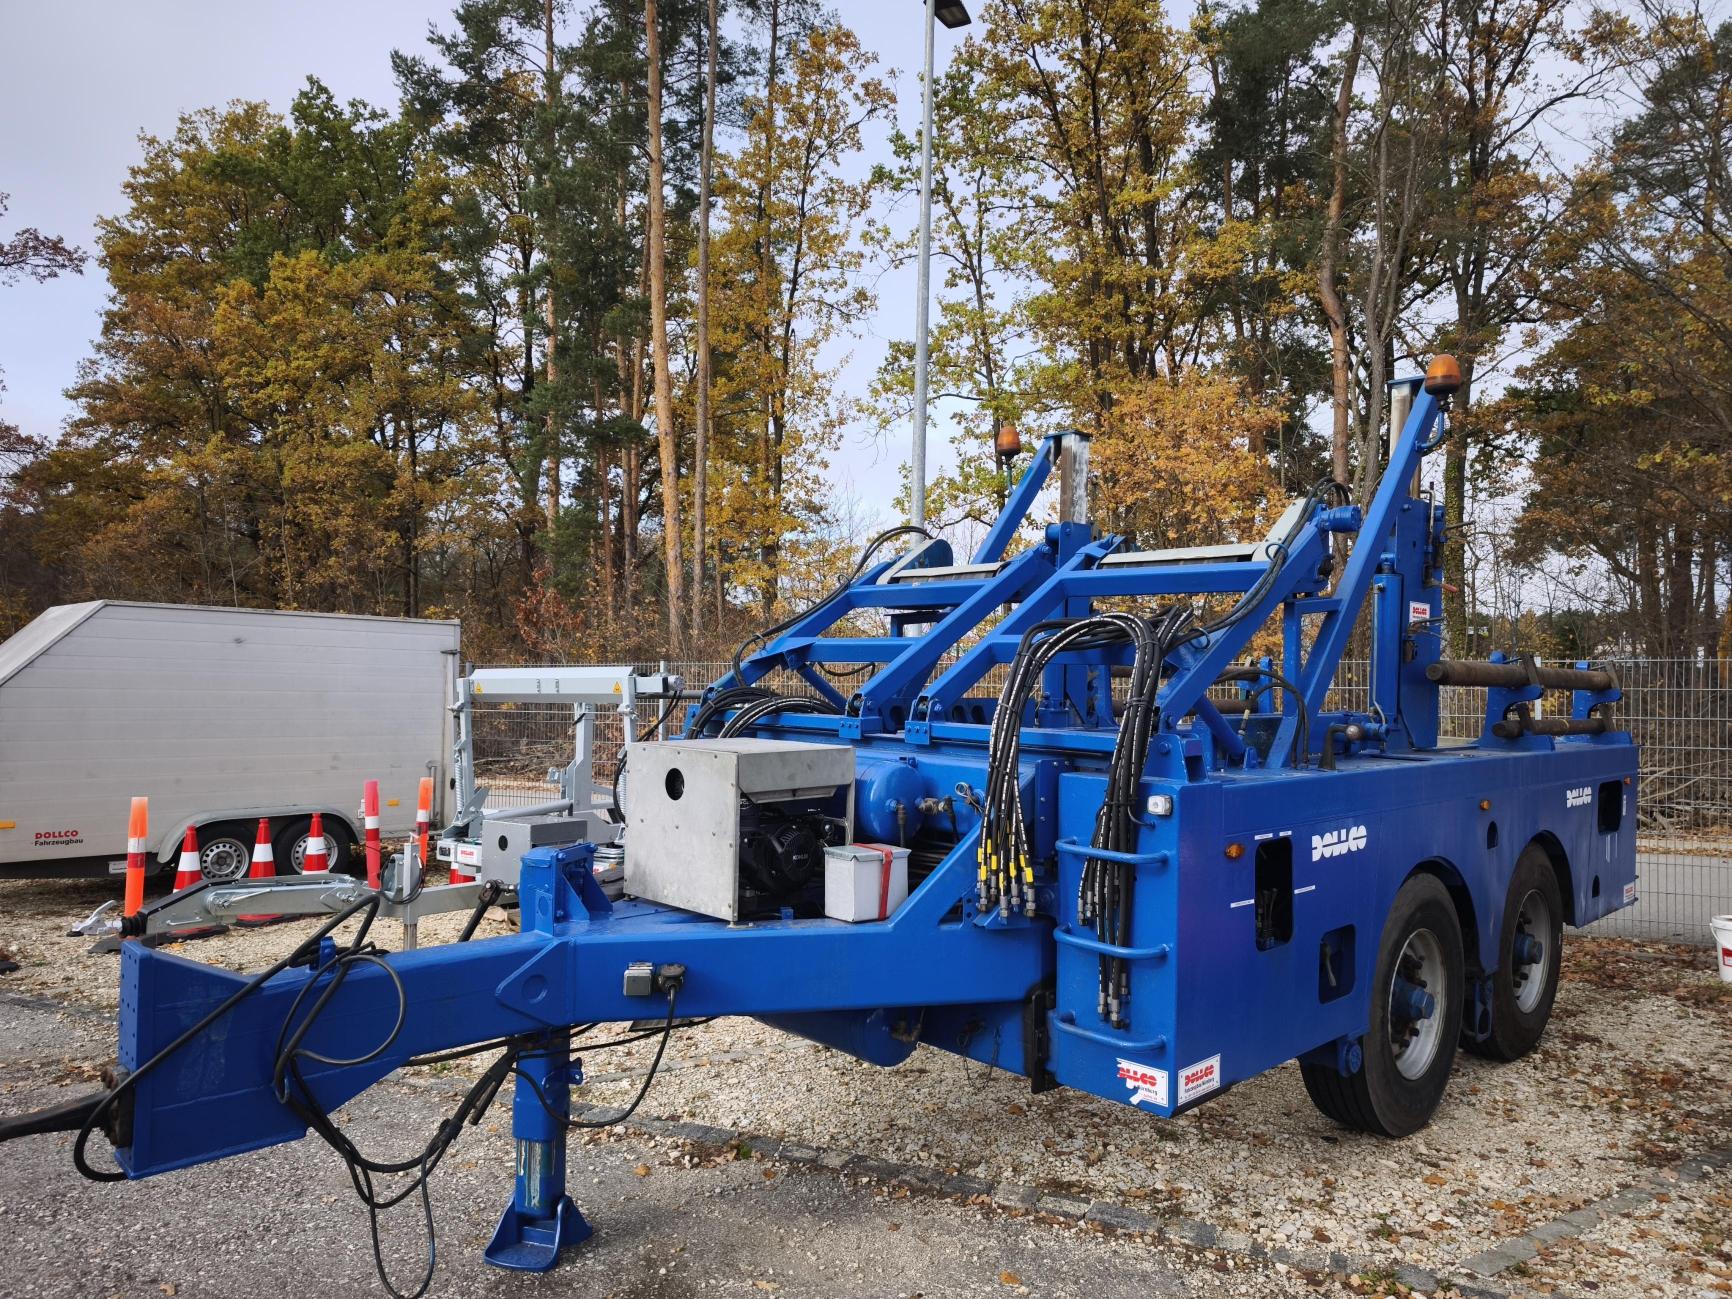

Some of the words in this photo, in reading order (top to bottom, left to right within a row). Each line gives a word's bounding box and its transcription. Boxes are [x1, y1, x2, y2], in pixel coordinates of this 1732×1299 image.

[1566, 786, 1592, 808] DOLLCO
[34, 838, 84, 846] Fahrzeugbau
[35, 830, 78, 839] DOLLCO
[1311, 825, 1367, 862] DOLLCO
[1184, 1064, 1214, 1087] DOLLCO
